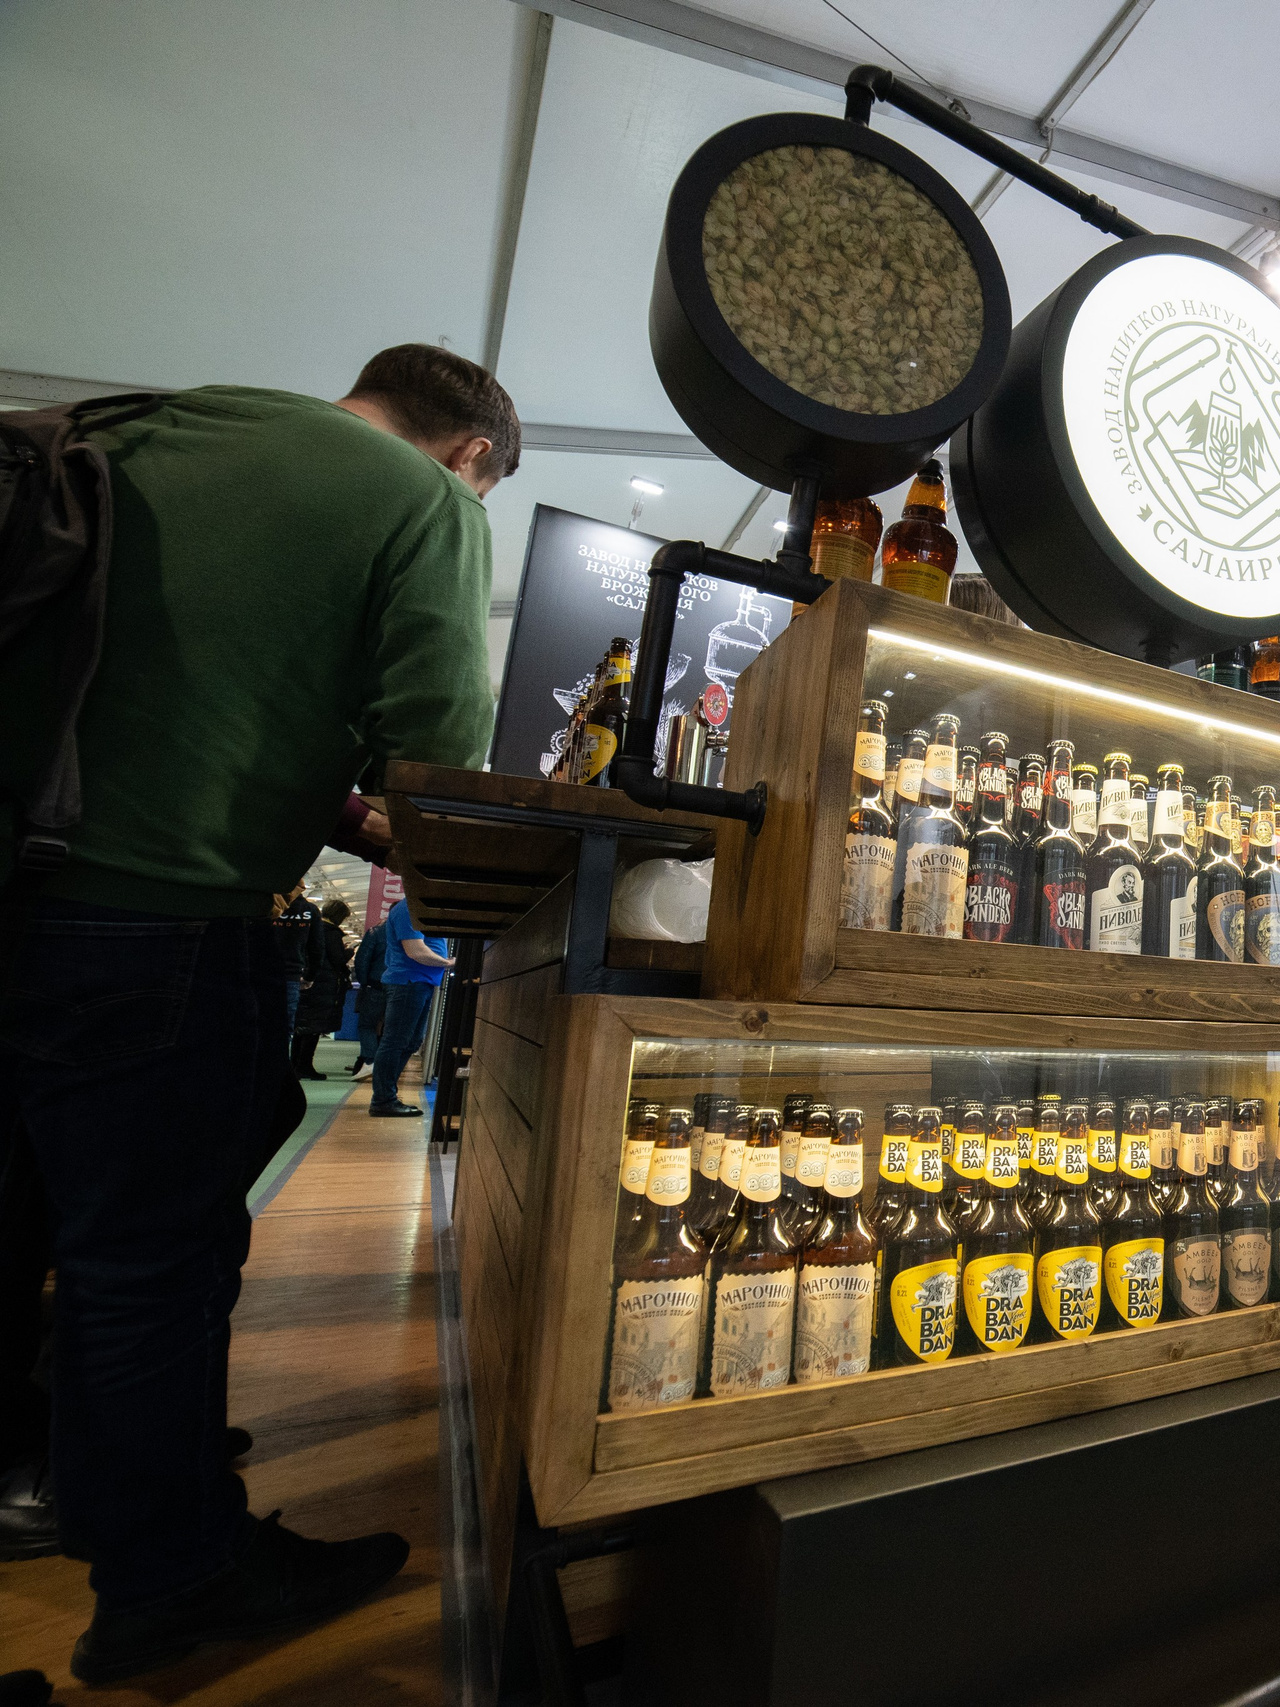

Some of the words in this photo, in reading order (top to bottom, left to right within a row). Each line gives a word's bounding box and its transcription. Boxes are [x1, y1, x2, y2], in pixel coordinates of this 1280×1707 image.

[1103, 301, 1177, 400] НАПИТКОВ
[1104, 408, 1143, 495] ЗАВОД
[577, 544, 630, 570] ЗАВОД
[1153, 519, 1273, 582] САЛАИР
[962, 1139, 985, 1150] DRA
[993, 1146, 1017, 1157] DRA
[1038, 1147, 1055, 1157] BA
[1097, 1145, 1113, 1155] BA
[887, 1152, 905, 1163] BA
[962, 1149, 979, 1160] BA
[992, 1156, 1011, 1167] BA
[1038, 1156, 1056, 1166] DA
[1065, 1154, 1082, 1164] BA
[1130, 1150, 1146, 1160] BA
[887, 1162, 905, 1173] DA
[921, 1160, 939, 1171] BA
[962, 1158, 985, 1169] DAN
[992, 1166, 1018, 1178] DAN
[1128, 1276, 1160, 1292] DRA
[1060, 1286, 1095, 1303] DRA
[1128, 1290, 1151, 1306] BA
[986, 1295, 1024, 1313] DRA
[1059, 1301, 1083, 1317] BA
[1127, 1302, 1160, 1320] DAN
[921, 1302, 954, 1323] DRA
[985, 1312, 1011, 1327] BA
[920, 1321, 945, 1339] BA
[1059, 1313, 1094, 1332] DAN
[985, 1323, 1023, 1343] DAN
[920, 1332, 953, 1355] DAN
